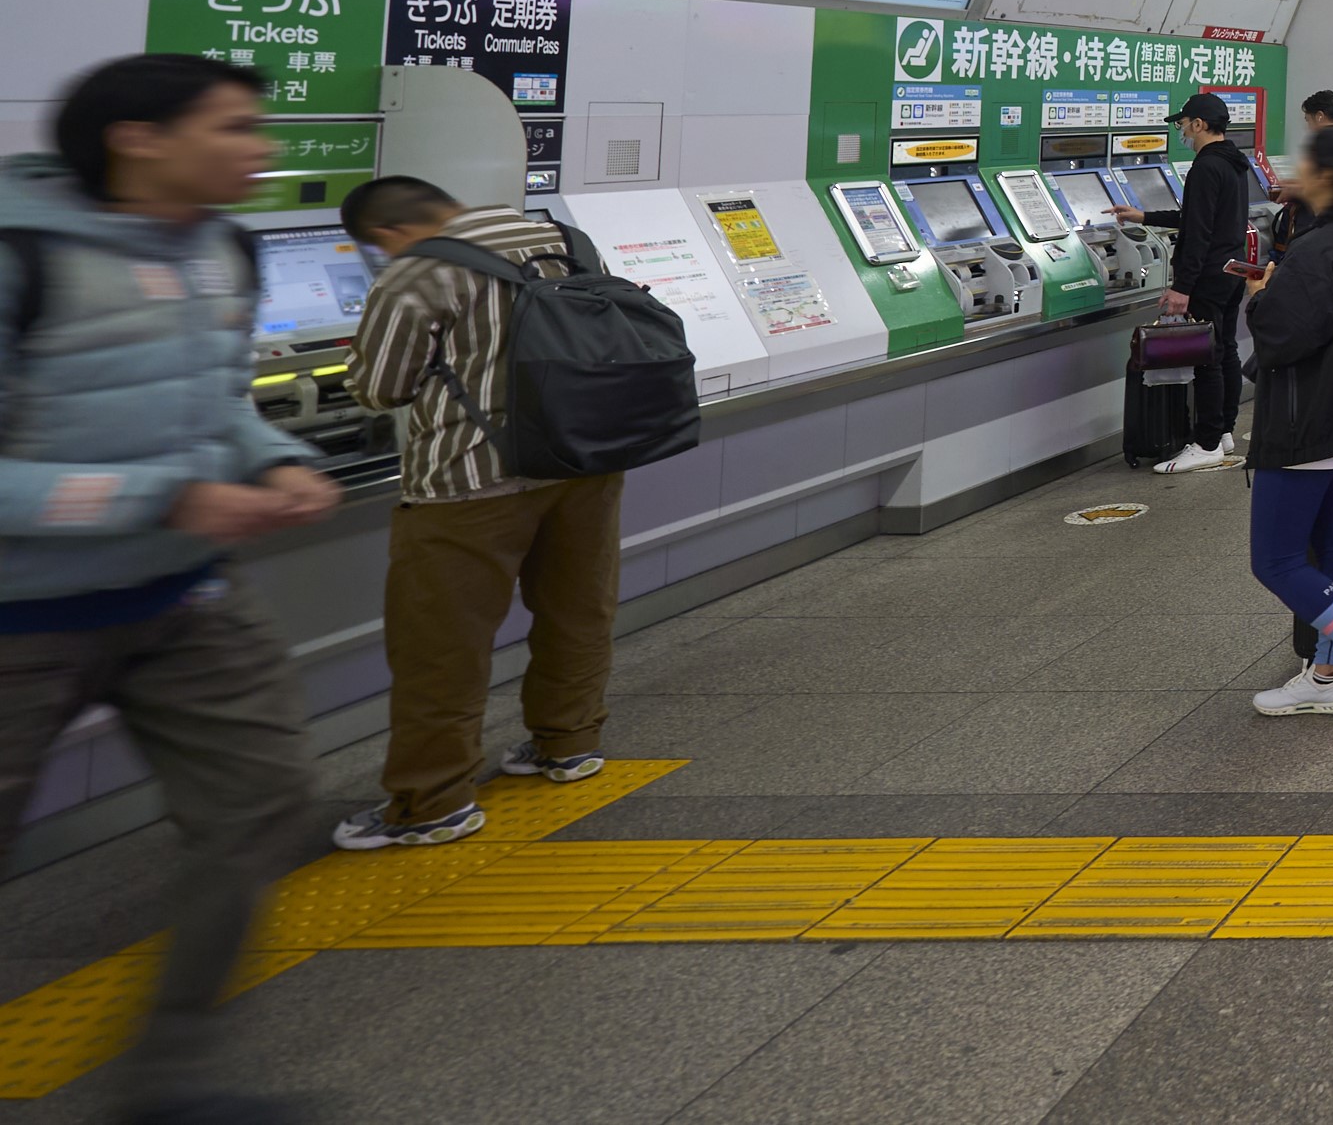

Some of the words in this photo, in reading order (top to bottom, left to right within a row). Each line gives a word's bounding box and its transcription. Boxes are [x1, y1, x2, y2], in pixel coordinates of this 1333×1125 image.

[226, 20, 319, 45] Tickets
[414, 30, 466, 50] Tickets
[484, 33, 536, 53] Commuter
[537, 37, 559, 54] Pass
[287, 51, 337, 73] 車票
